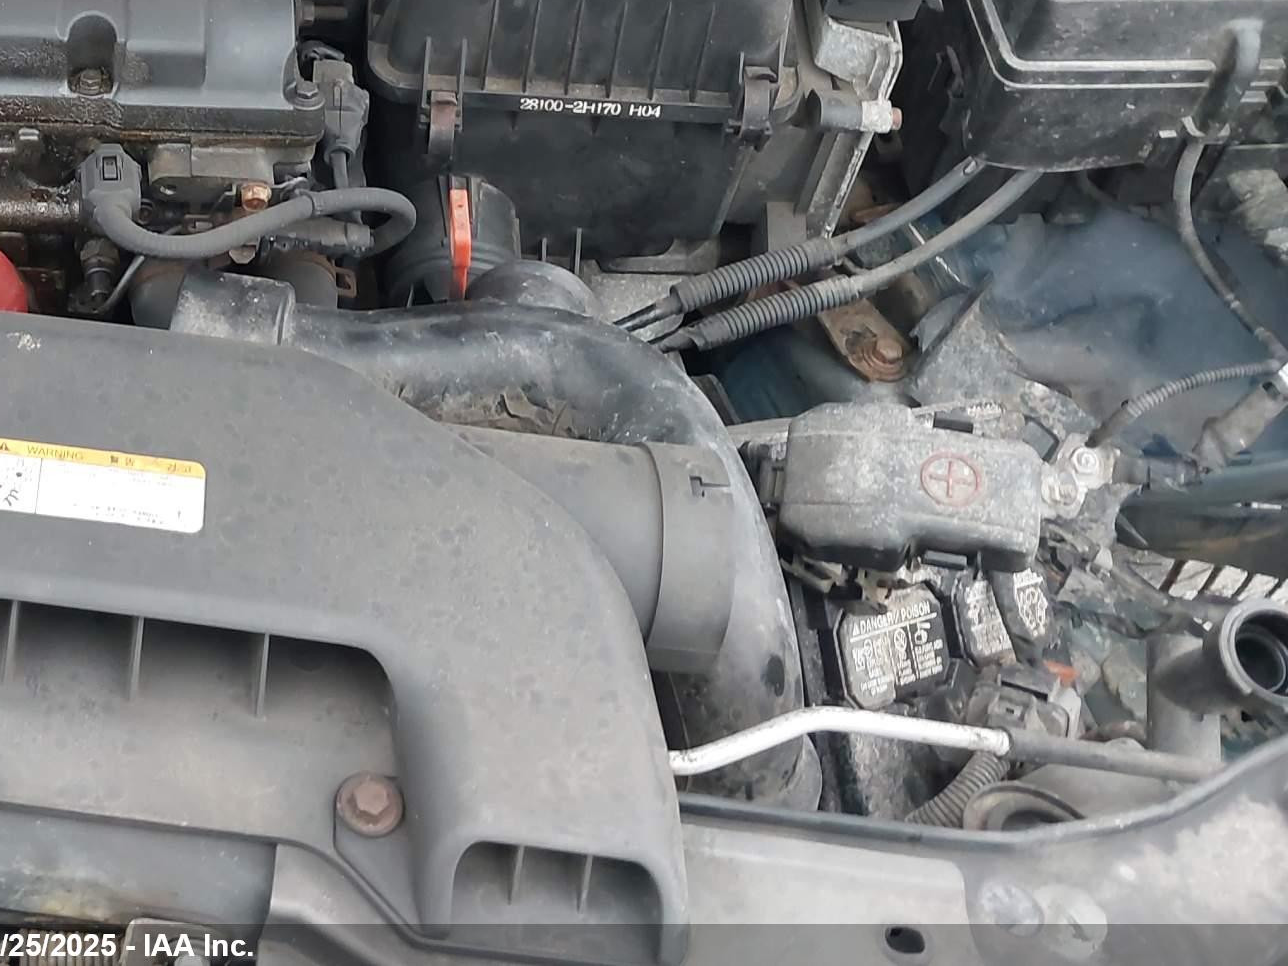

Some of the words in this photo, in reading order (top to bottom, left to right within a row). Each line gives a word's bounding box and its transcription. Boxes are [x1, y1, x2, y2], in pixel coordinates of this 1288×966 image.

[520, 98, 622, 116] 28100-2H170
[629, 104, 661, 118] H04
[26, 444, 84, 461] WARNING
